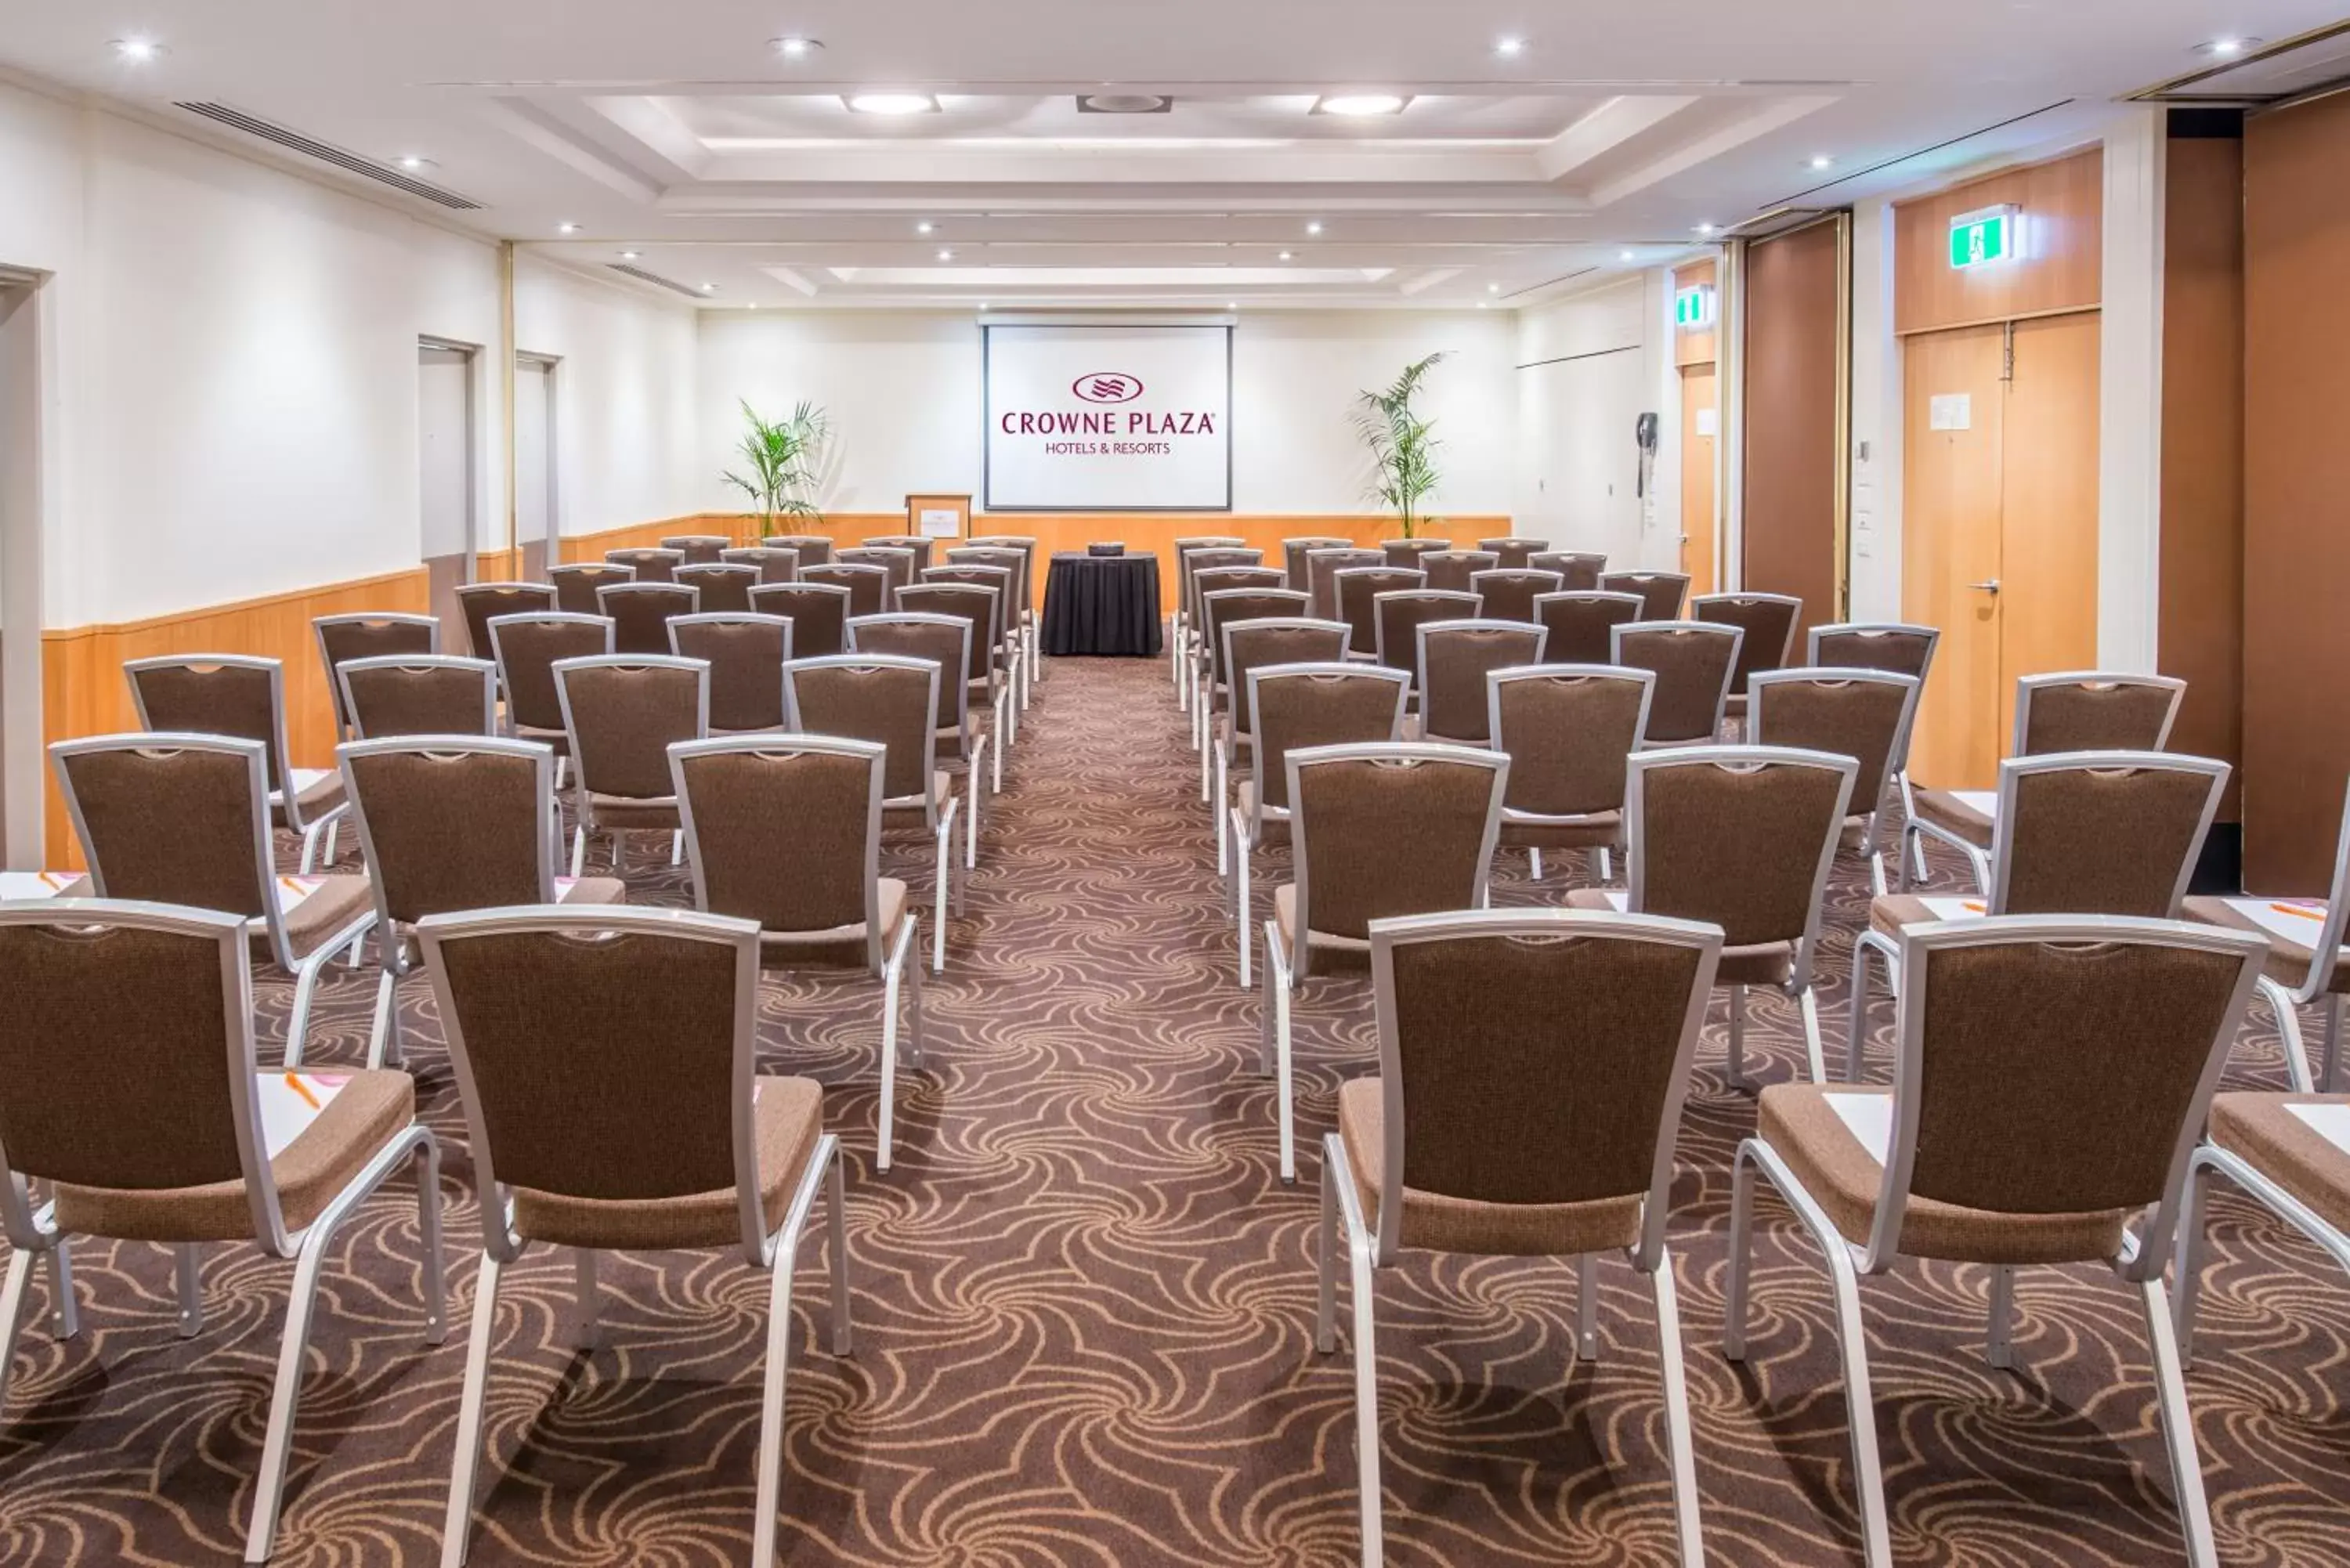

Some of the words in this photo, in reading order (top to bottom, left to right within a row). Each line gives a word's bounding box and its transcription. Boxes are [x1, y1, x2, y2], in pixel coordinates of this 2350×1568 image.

[1002, 412, 1115, 435] CROWNE
[1046, 443, 1096, 455] HOTELS
[1100, 443, 1109, 455] &
[1113, 442, 1170, 455] RESORTS
